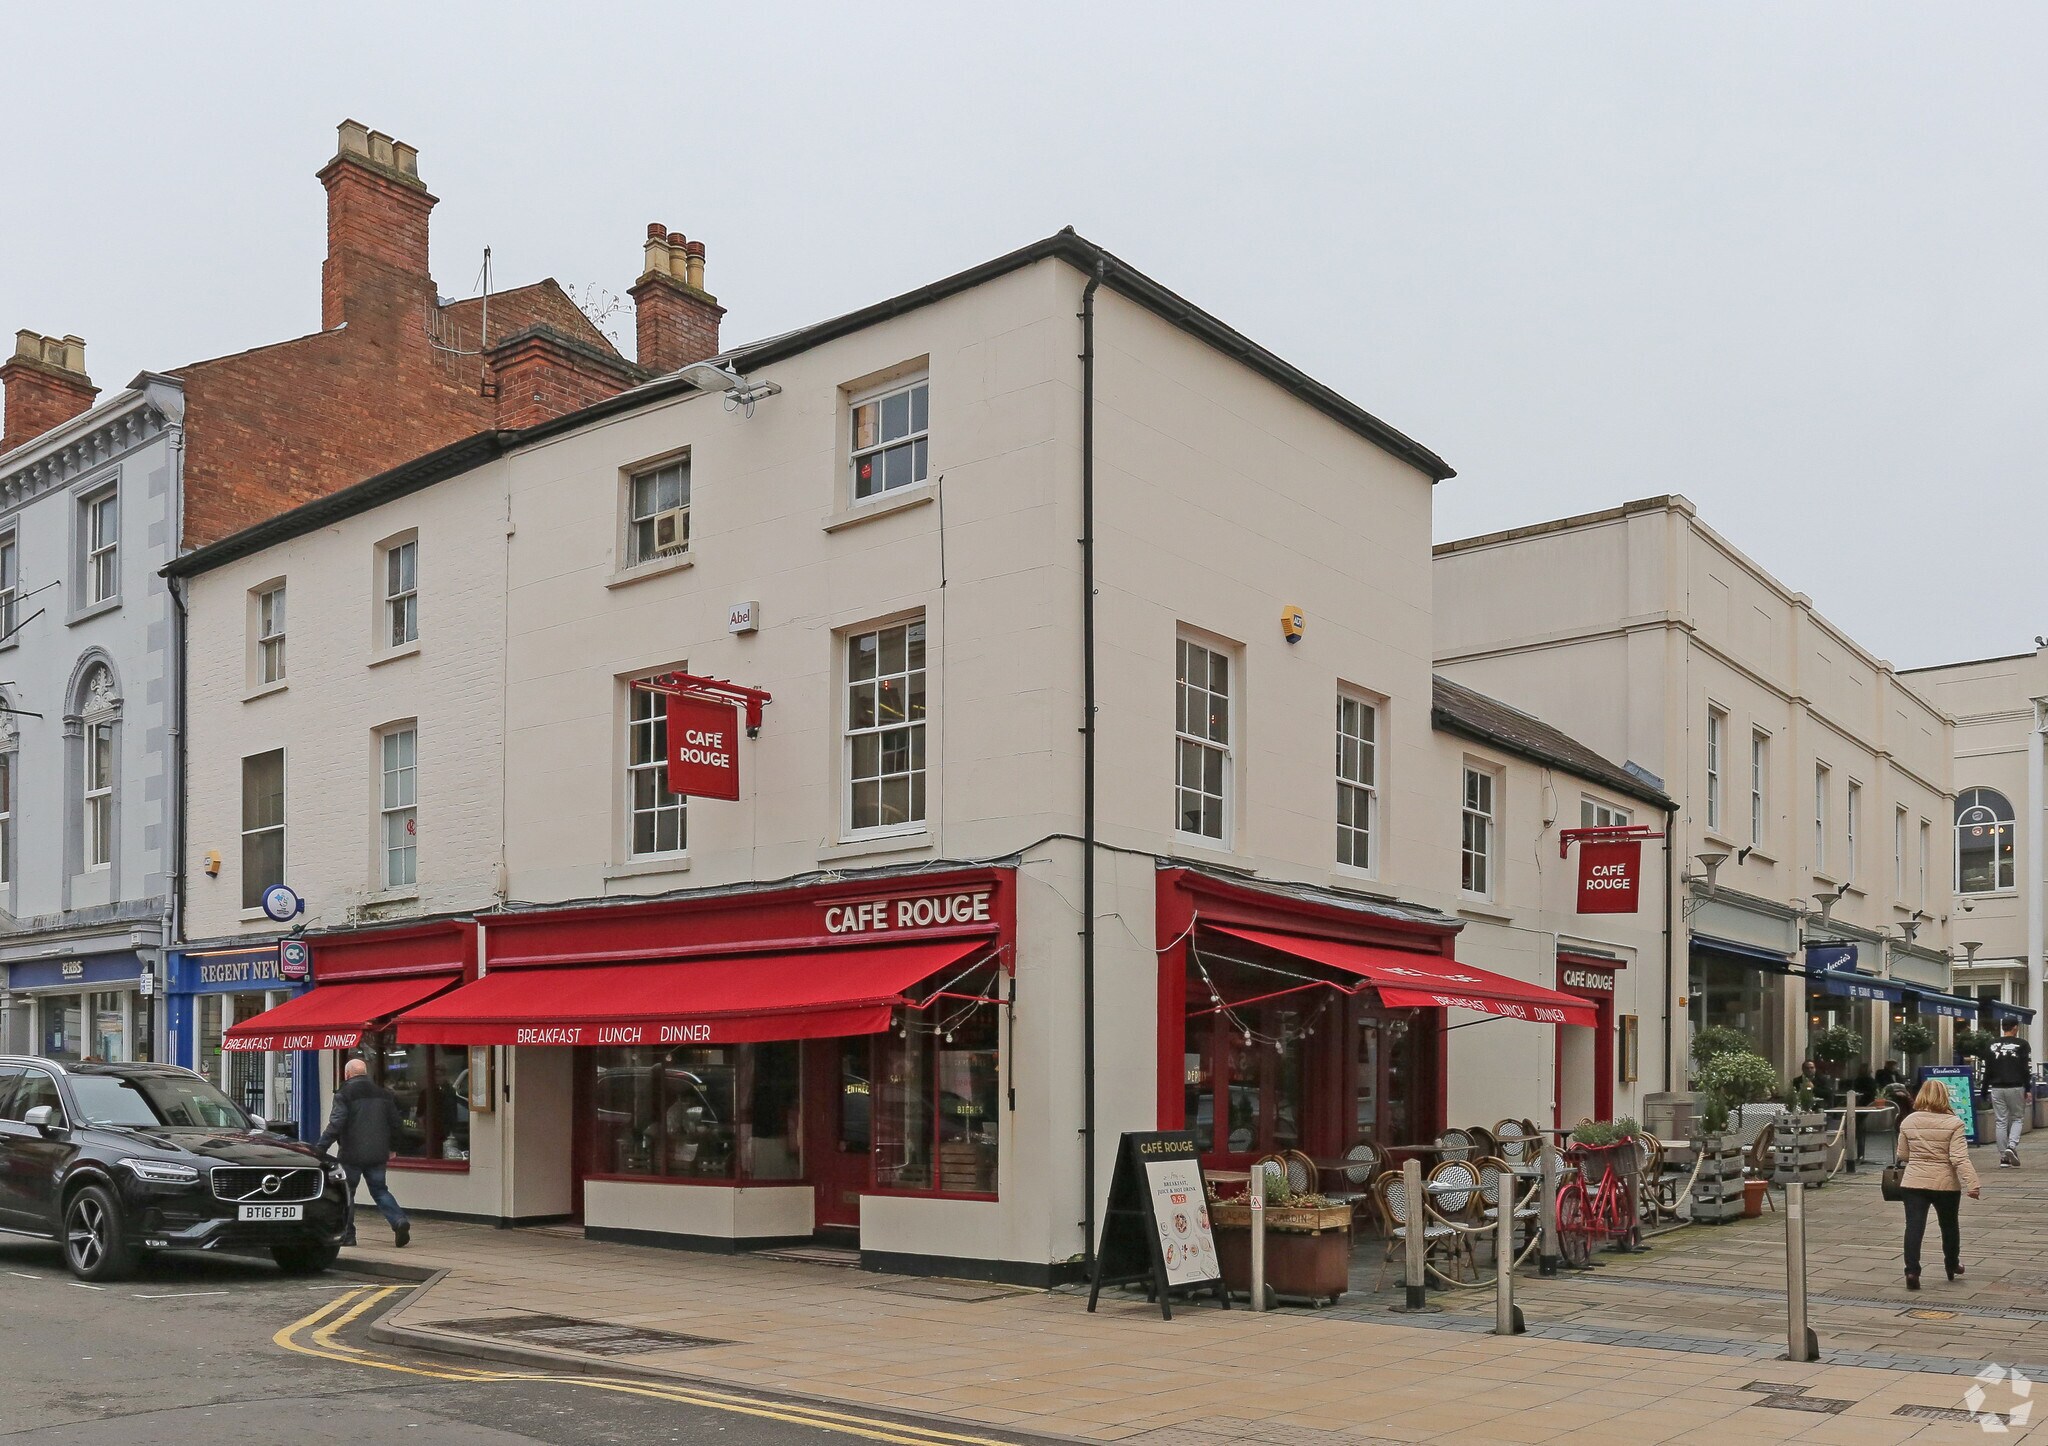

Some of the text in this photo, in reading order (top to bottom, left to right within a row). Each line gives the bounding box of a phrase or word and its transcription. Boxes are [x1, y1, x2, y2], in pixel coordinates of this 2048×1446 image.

[730, 609, 750, 625] Abel
[686, 729, 723, 749] CAFÉ
[680, 748, 730, 768] ROUGE
[1592, 863, 1626, 877] CAFÉ
[1586, 879, 1631, 890] ROUGE
[898, 893, 991, 927] ROUGE
[201, 963, 249, 983] REGENT
[1586, 973, 1613, 990] ROUGE
[1432, 995, 1567, 1022] BREAKFAST LUNCH DINNER
[225, 1033, 357, 1050] BREAKFAST LUNCH DINNER
[517, 1025, 711, 1044] BREAKFAST LUNCH DINNER
[1165, 1141, 1194, 1153] ROUGE
[246, 1206, 296, 1218] BT16 FBD
